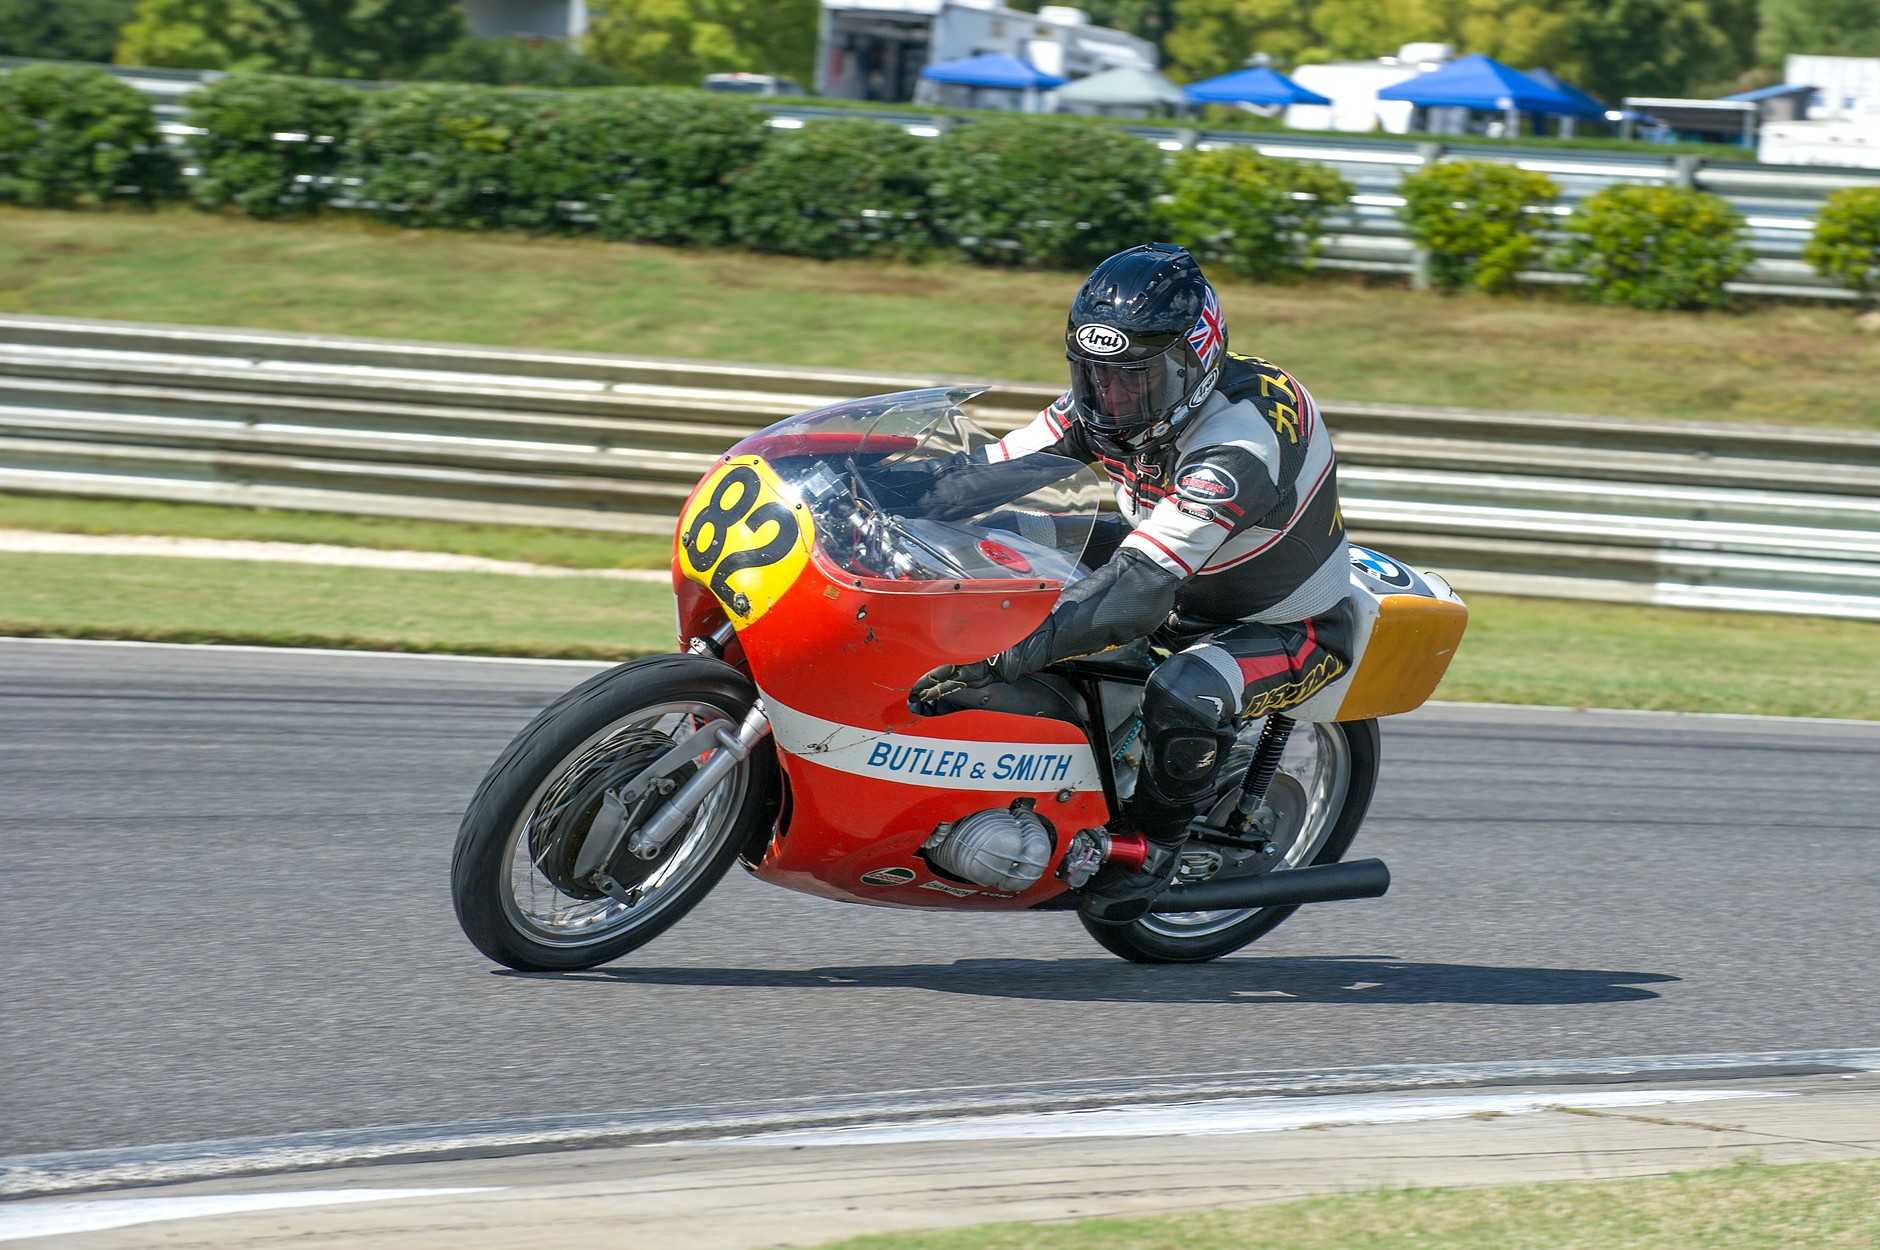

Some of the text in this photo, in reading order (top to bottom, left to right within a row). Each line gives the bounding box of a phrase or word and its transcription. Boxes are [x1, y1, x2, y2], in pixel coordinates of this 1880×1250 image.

[1079, 328, 1121, 349] Arai
[686, 466, 799, 618] 82
[867, 741, 1073, 781] BUTLER & SMITH
